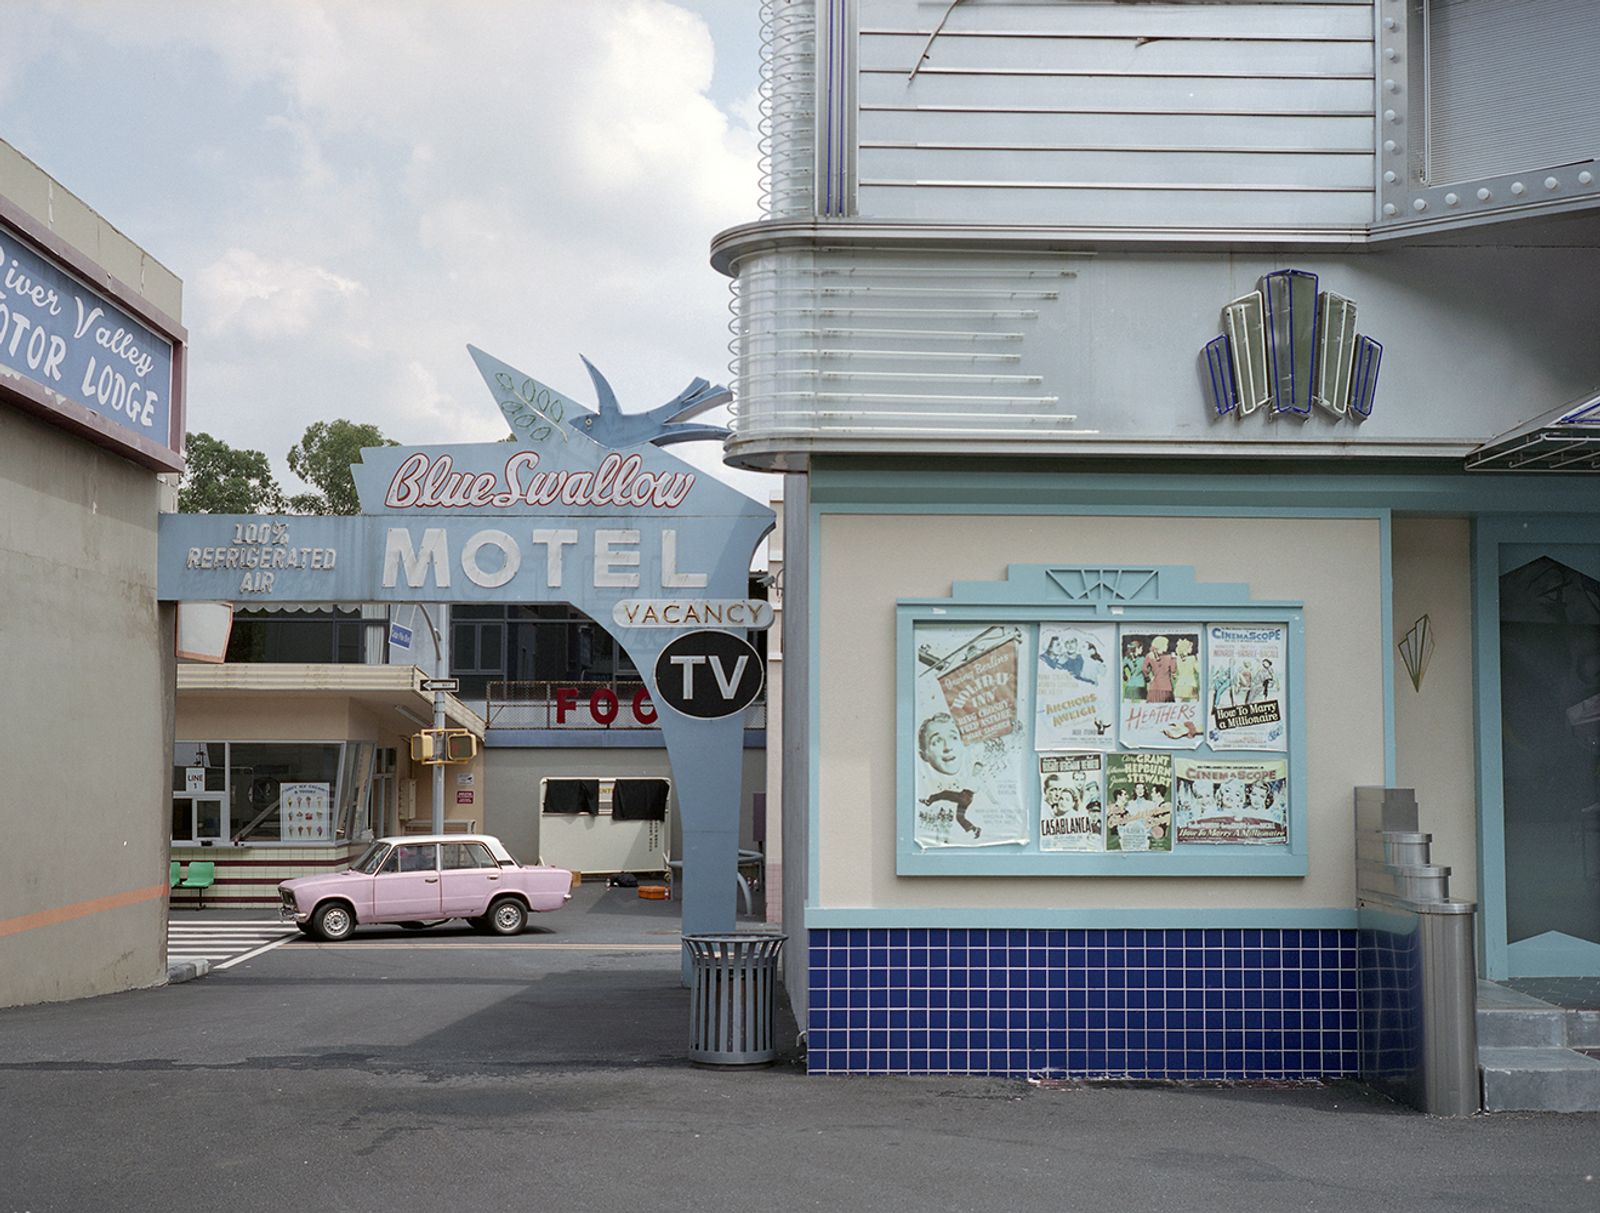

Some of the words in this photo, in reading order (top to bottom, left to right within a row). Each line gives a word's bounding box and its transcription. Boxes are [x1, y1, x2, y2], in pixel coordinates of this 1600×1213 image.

[0, 246, 61, 315] iver
[74, 296, 154, 377] Valley
[82, 355, 158, 427] LODGE
[384, 452, 496, 508] Blue
[492, 451, 695, 508] Swallow
[232, 521, 290, 546] 100%
[186, 547, 337, 570] REFRIGERATED
[382, 527, 708, 588] MOTEL
[240, 571, 275, 594] AIR
[623, 604, 764, 624] VACANCY
[670, 655, 750, 700] TV
[1126, 704, 1196, 730] HEATHERS
[1217, 709, 1236, 719] How
[1236, 706, 1248, 716] To
[1249, 703, 1277, 715] Marry
[1227, 712, 1279, 727] Millionaire
[1124, 763, 1171, 776] HEPBURN
[1136, 754, 1170, 766] GRANT
[188, 774, 203, 782] LINE
[1127, 774, 1171, 787] STEWART
[1041, 817, 1091, 835] CASABLANCA
